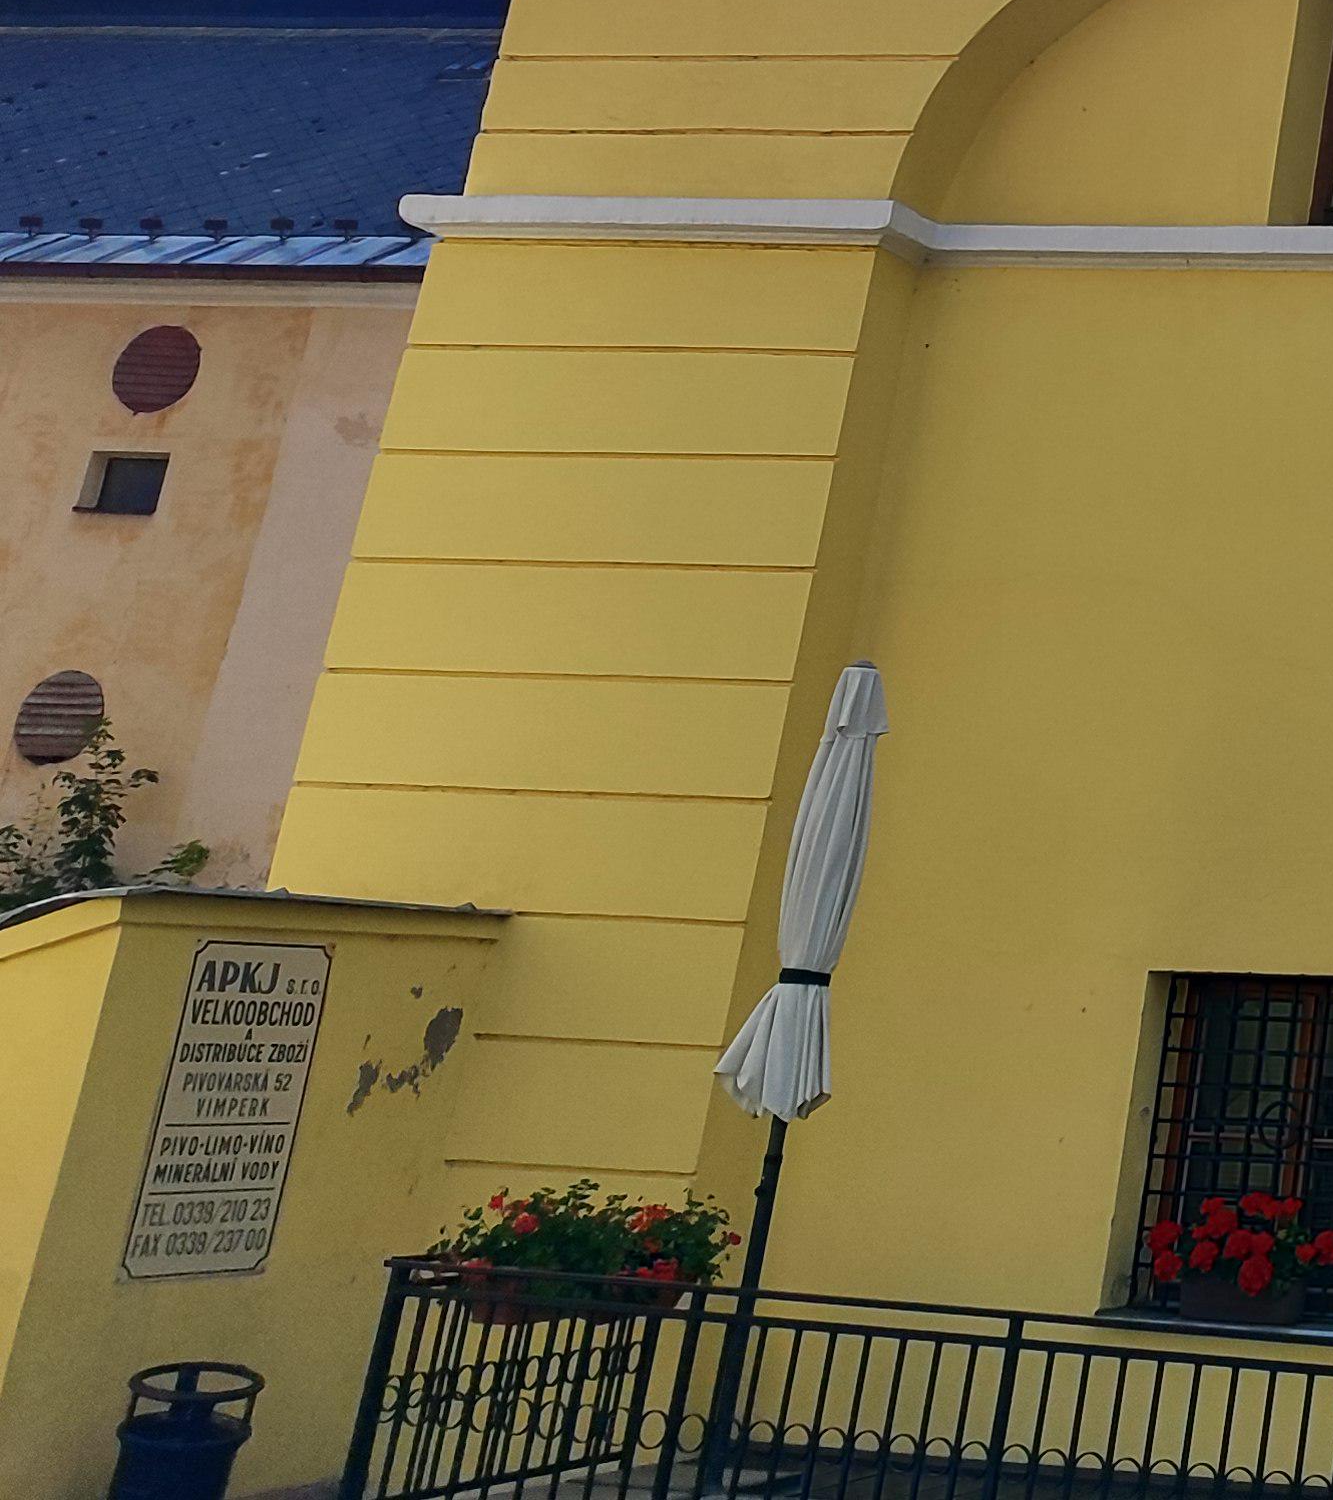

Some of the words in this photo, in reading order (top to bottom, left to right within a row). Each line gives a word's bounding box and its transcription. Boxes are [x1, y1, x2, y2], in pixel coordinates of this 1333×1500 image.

[196, 960, 281, 995] APKJ
[191, 998, 316, 1027] VELKOOBCHOD
[244, 1028, 253, 1041] A
[179, 1043, 266, 1063] DISTRIBUCE
[268, 1038, 310, 1063] ZBOŽÍ
[182, 1068, 270, 1092] PIVOVARSKÁ
[274, 1073, 293, 1092] 52
[196, 1098, 270, 1117] VIMPERK
[153, 1157, 238, 1184] MINERÁLNÍ
[242, 1160, 280, 1181] VODY
[250, 1197, 272, 1221] 23
[130, 1233, 163, 1259] FAX
